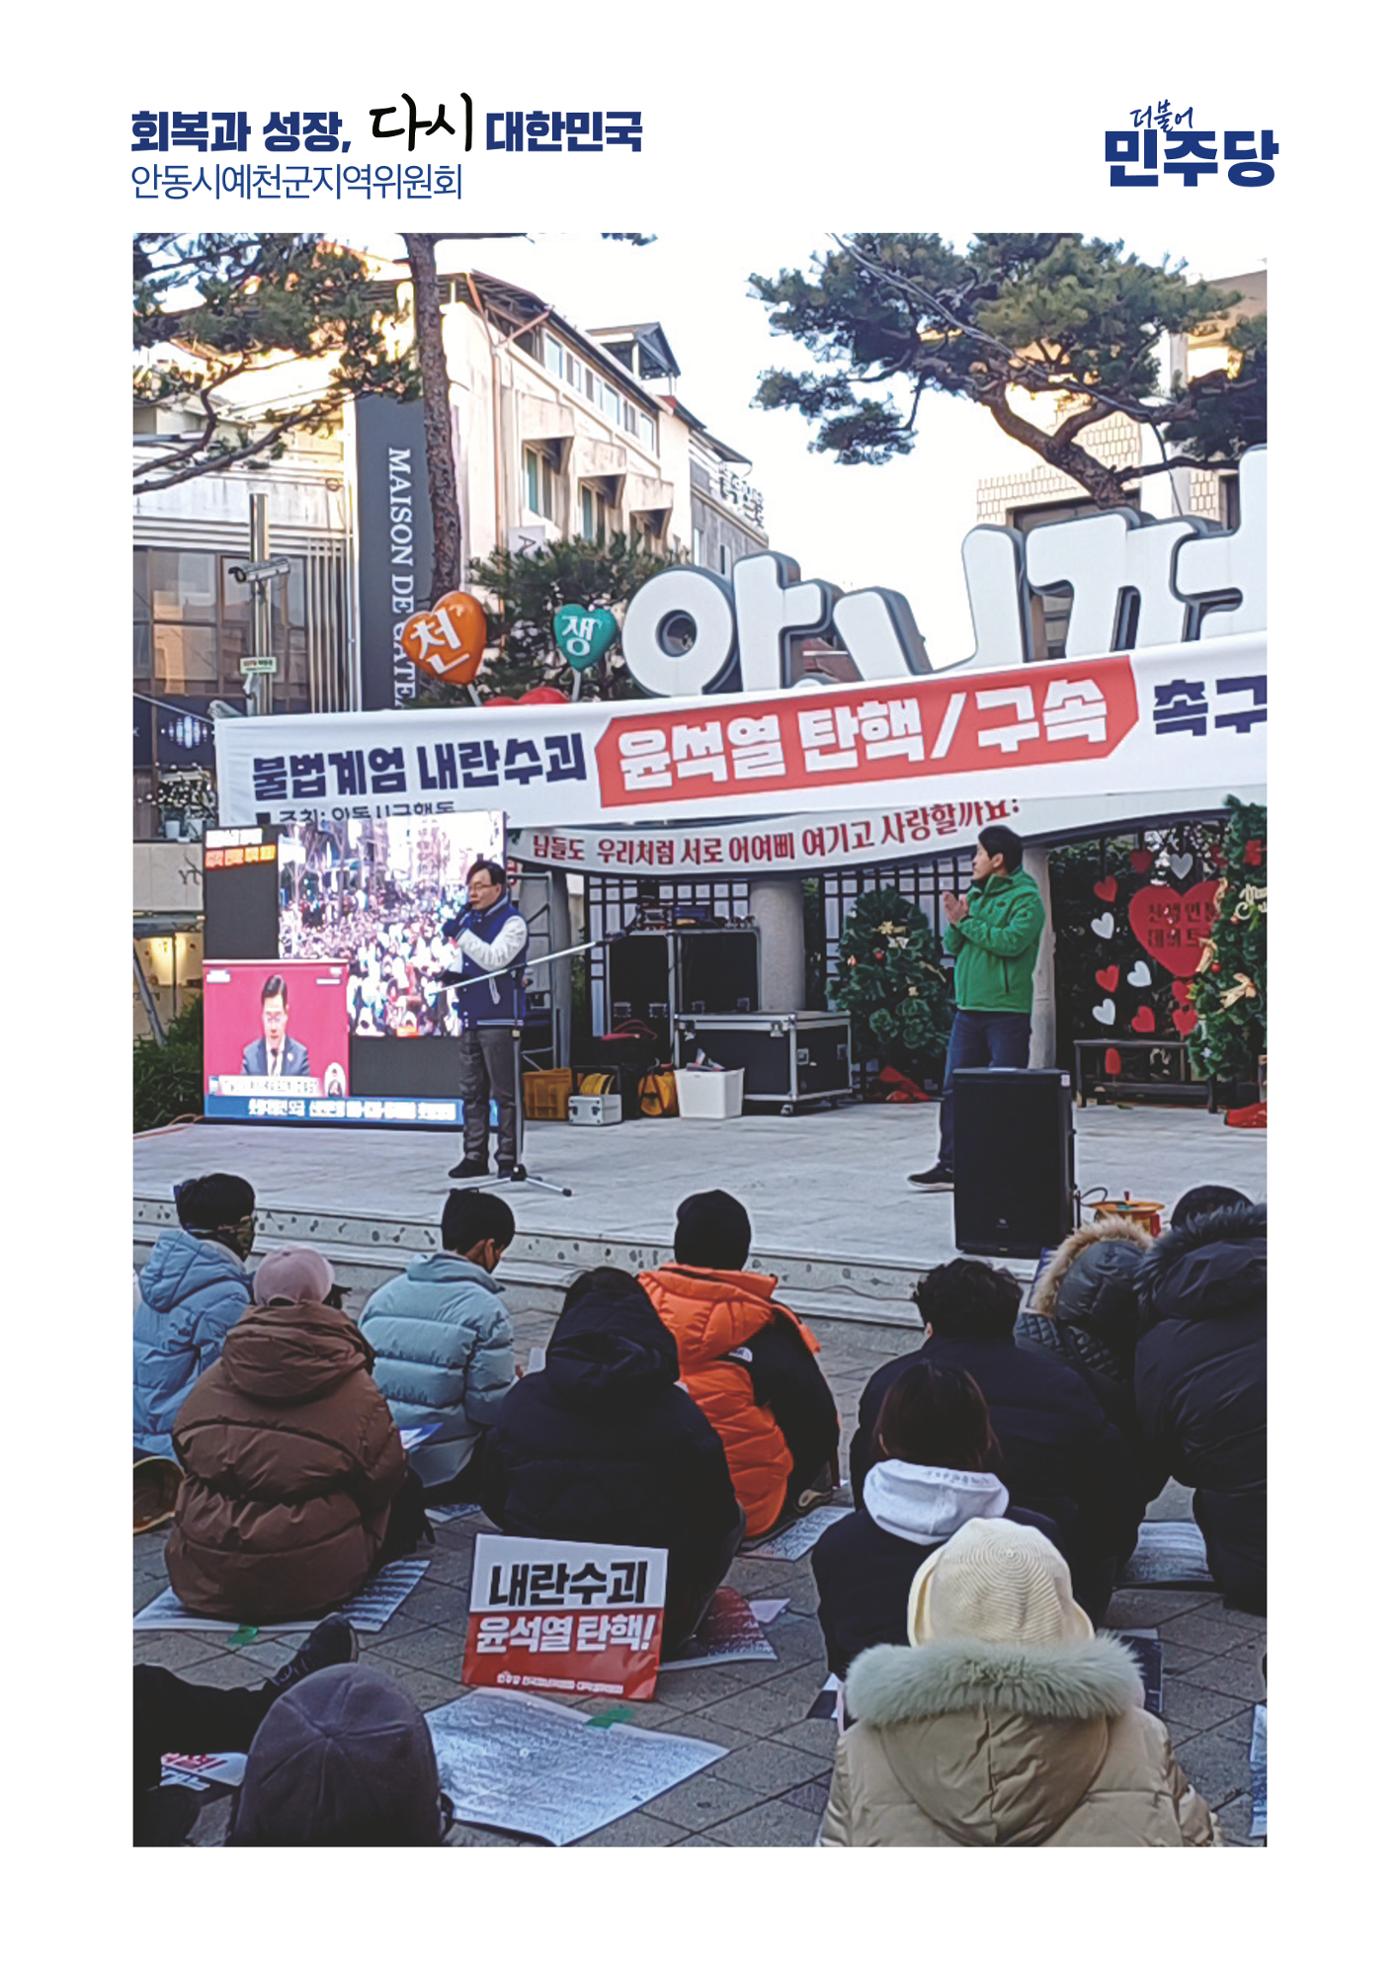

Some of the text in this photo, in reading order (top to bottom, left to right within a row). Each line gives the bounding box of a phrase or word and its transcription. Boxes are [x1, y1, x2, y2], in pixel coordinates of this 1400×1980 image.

[388, 447, 415, 567] MAISON
[391, 574, 415, 614] DE
[410, 606, 471, 675] 천
[560, 615, 602, 657] 생
[252, 747, 407, 801] 불법계엄
[416, 732, 587, 791] 내란수괴
[618, 714, 787, 791] 윤석열
[1152, 674, 1267, 737] 촉구
[532, 834, 586, 861] 남들도
[597, 838, 675, 866] 우리처럼
[680, 838, 724, 863] 서로
[728, 832, 795, 864] 어여삐
[802, 820, 875, 857] 여기고
[489, 1561, 648, 1606] 내란수괴
[476, 1613, 656, 1654] 윤석열 탄핵!
